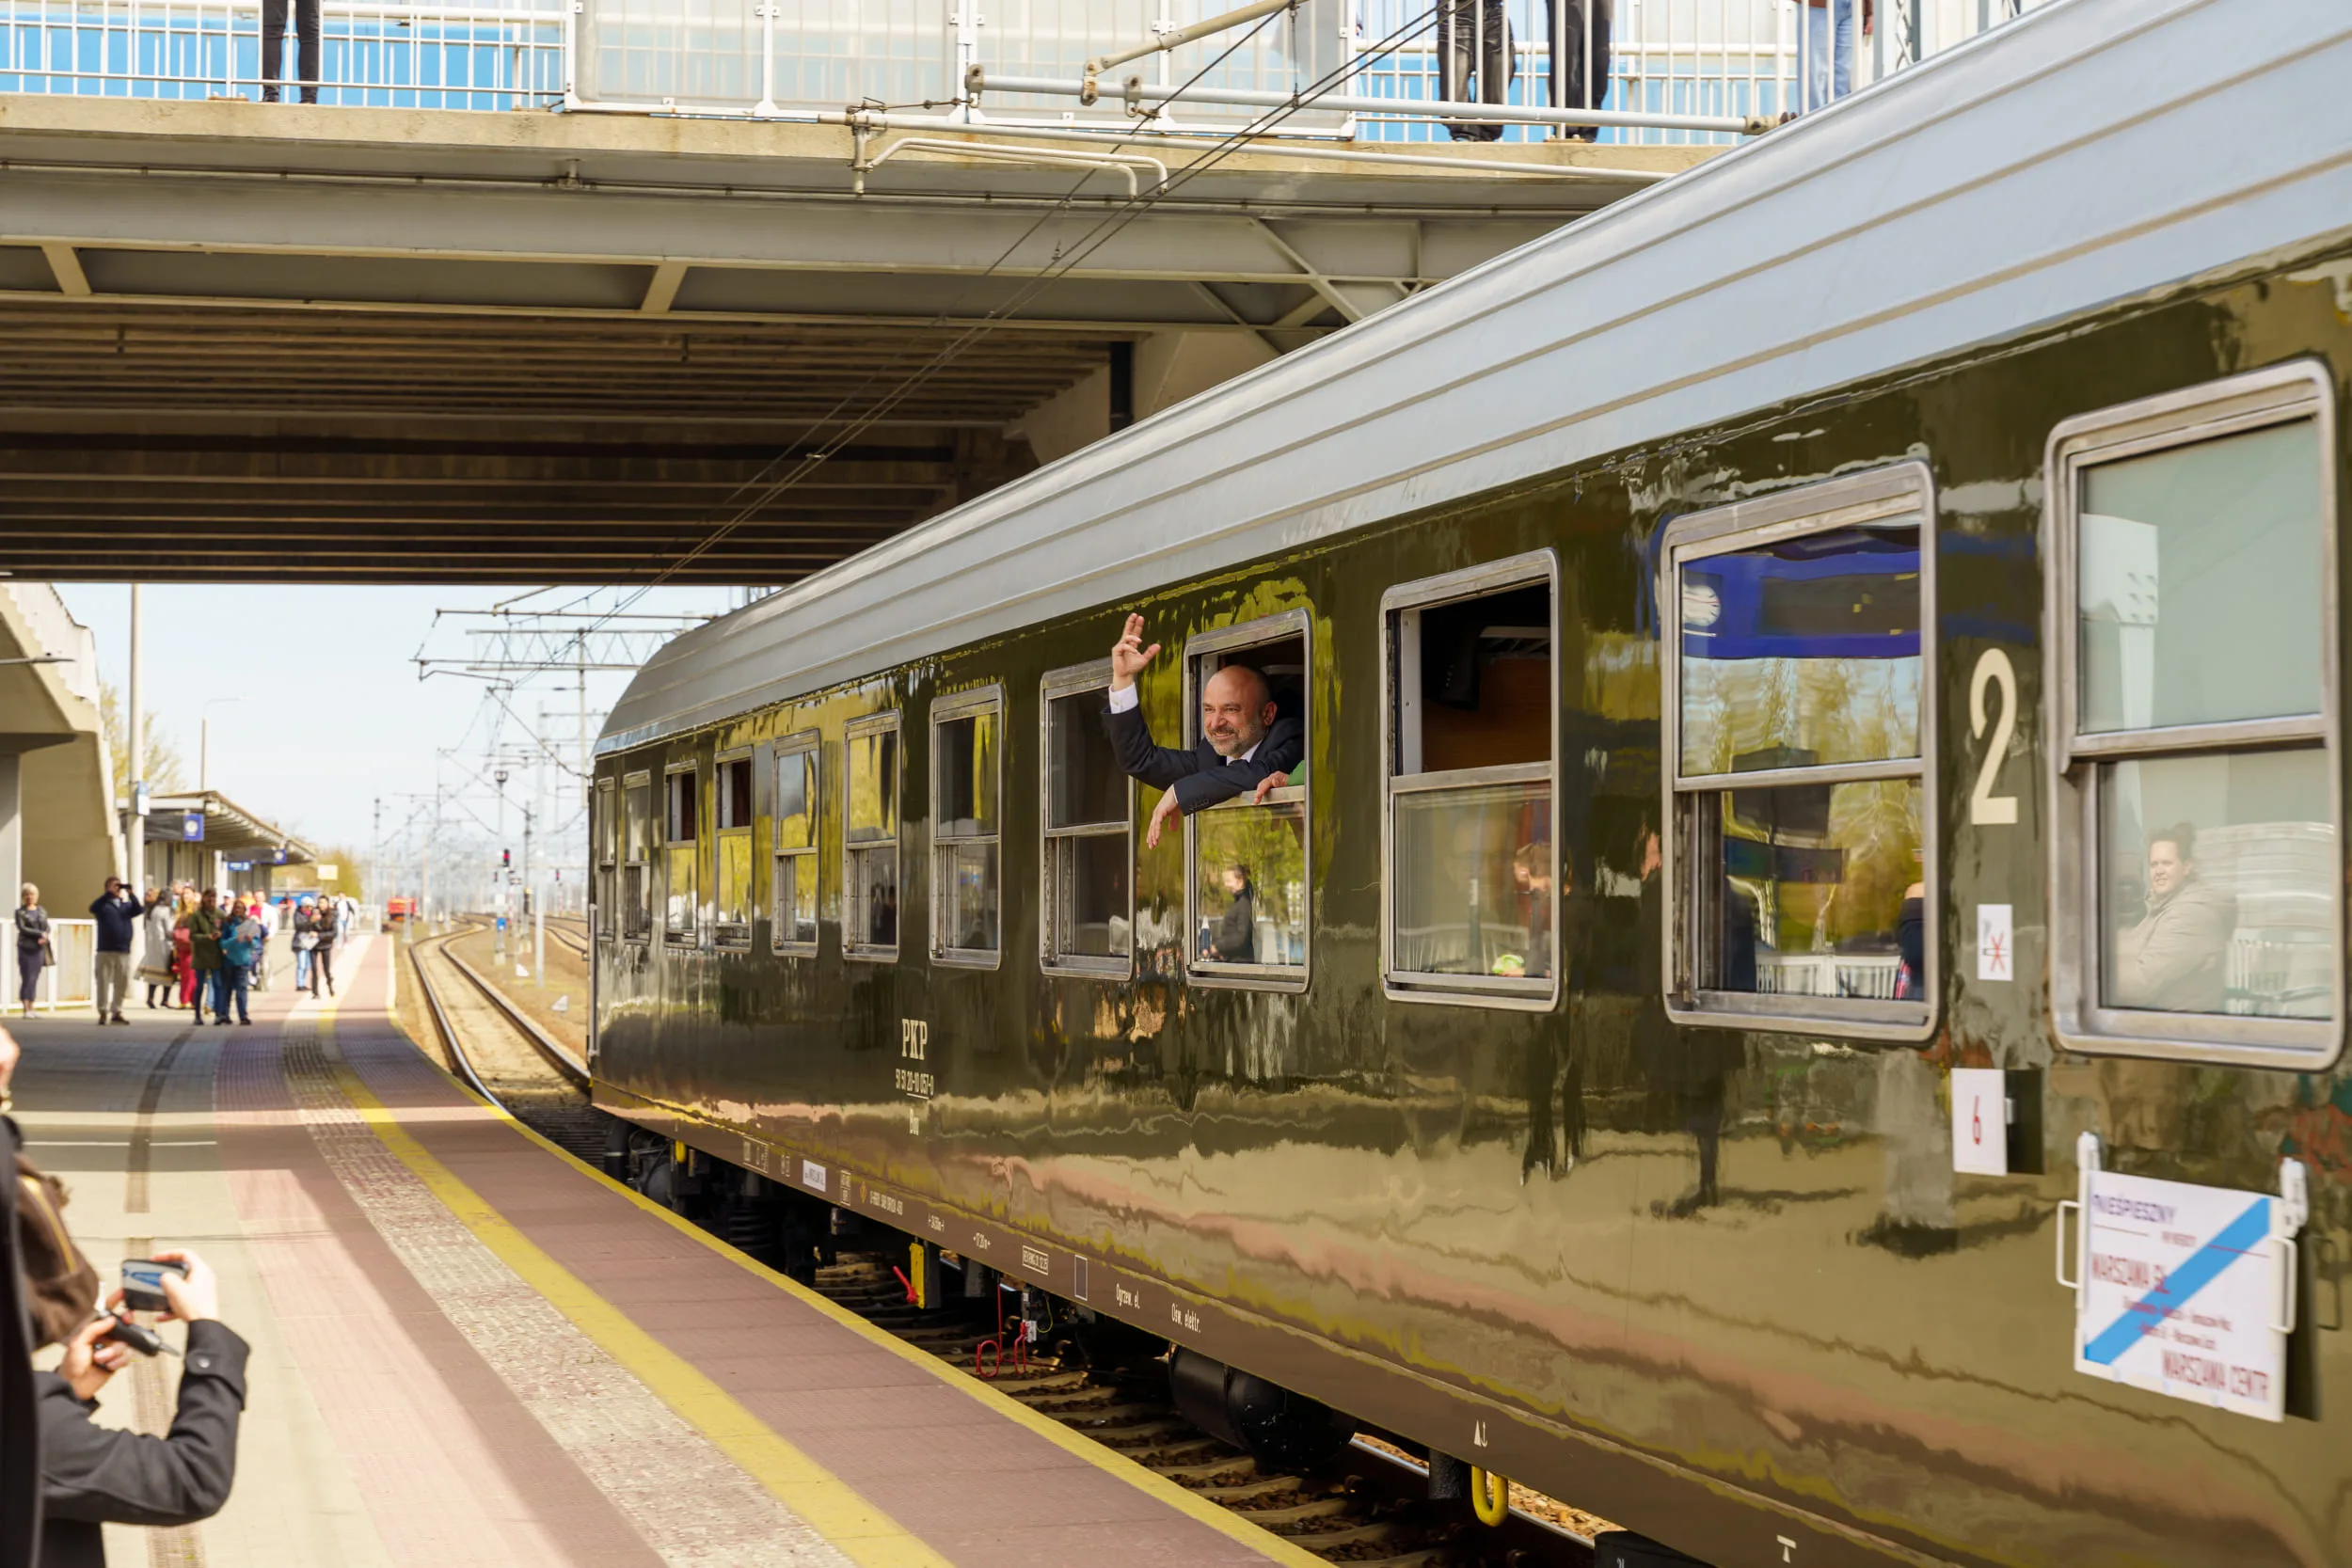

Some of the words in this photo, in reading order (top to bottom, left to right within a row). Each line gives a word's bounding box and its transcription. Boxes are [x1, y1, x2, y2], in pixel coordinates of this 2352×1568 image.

[1969, 647, 2018, 824] 2
[901, 1018, 928, 1060] PKP
[1973, 1095, 1982, 1146] 6
[2091, 1252, 2150, 1289] WARSZAWA
[1116, 1282, 1133, 1308] Ogrzew.
[1171, 1302, 1184, 1324] Ośw.
[1184, 1308, 1201, 1334] elektr.
[2162, 1349, 2226, 1391] WARSZAWA
